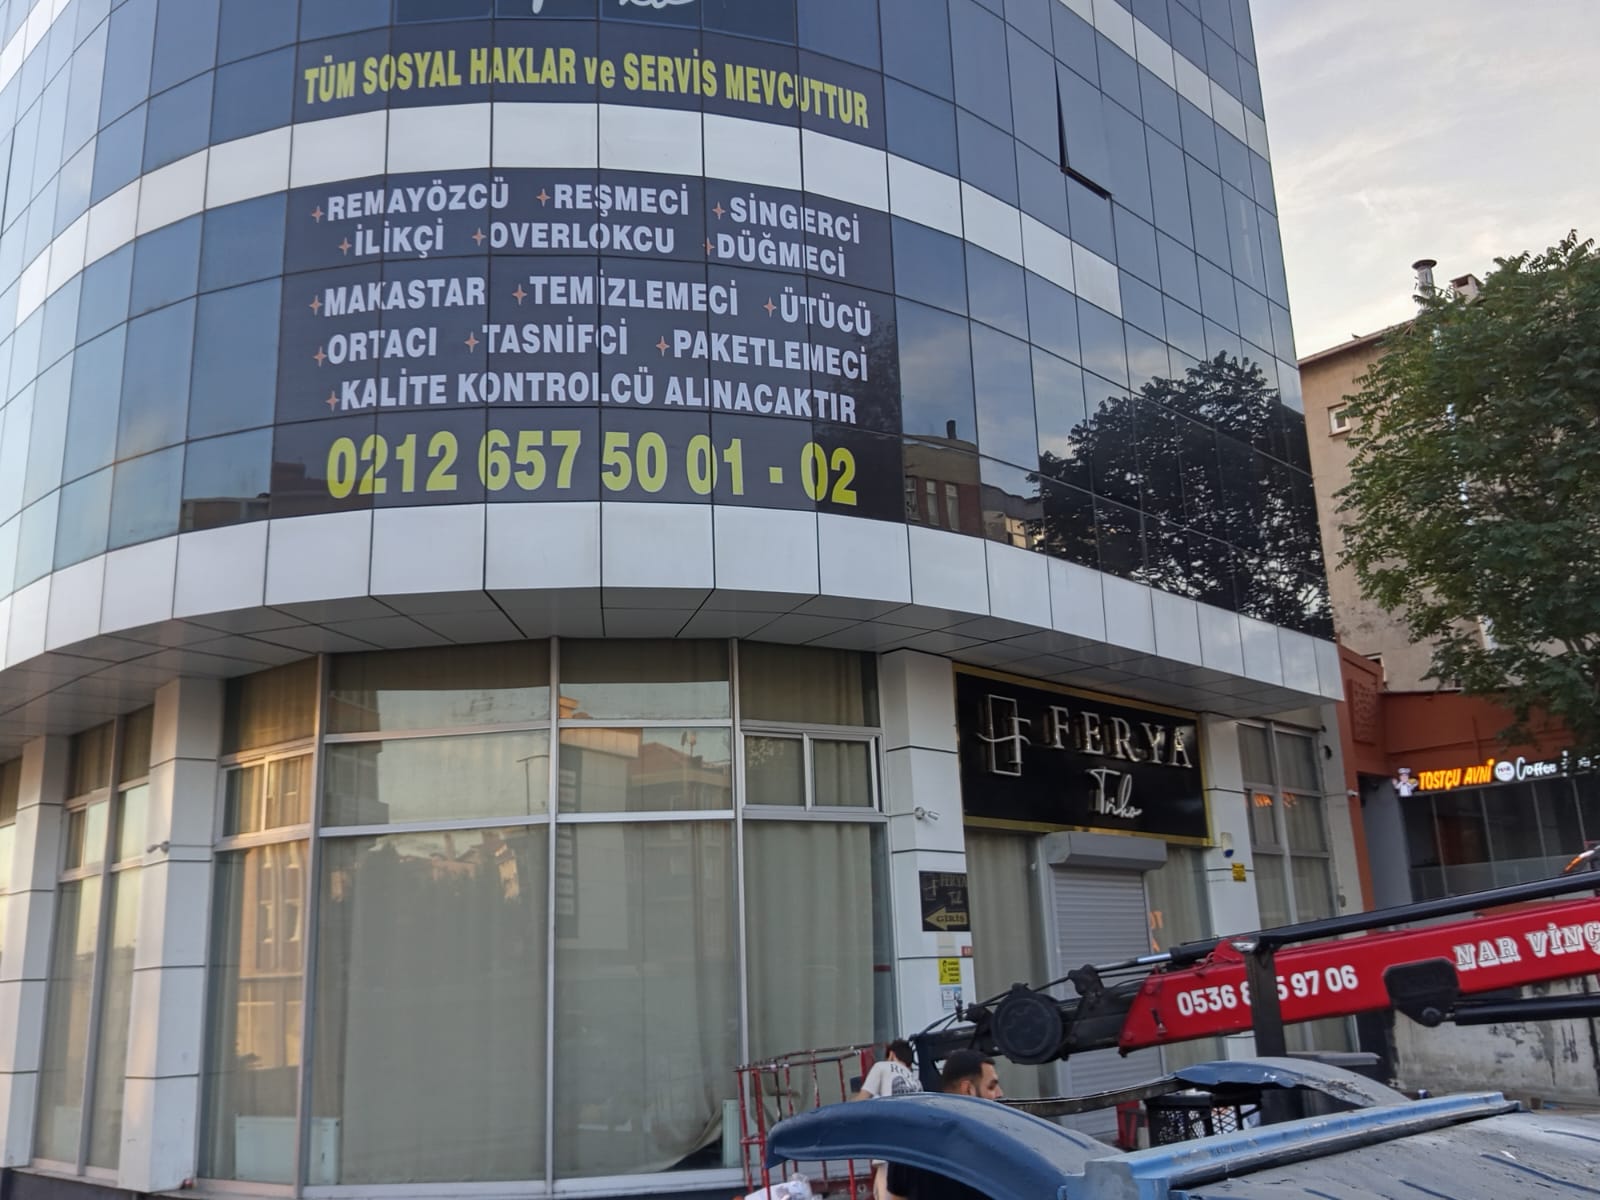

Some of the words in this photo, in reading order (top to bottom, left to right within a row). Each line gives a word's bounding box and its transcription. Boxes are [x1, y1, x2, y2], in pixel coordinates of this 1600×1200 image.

[305, 55, 354, 104] TÜM
[363, 49, 461, 92] SOSYAL
[470, 47, 576, 85] HAKLAR
[584, 58, 615, 88] ve
[623, 48, 717, 97] SERVİS
[725, 63, 868, 129] MEVCUTTUR
[327, 176, 509, 221] REMAYÖZCÜ
[554, 183, 689, 218] REŞMECİ
[730, 192, 860, 243] SİNGERCİ
[354, 219, 444, 258] İLİKÇİ
[489, 221, 674, 253] OVERLOKCU
[716, 227, 845, 277] DÜĞMECİ
[324, 276, 485, 317] MAKASTAR
[529, 271, 738, 316] TEMİZLEMECİ
[779, 287, 871, 336] ÜTÜCÜ
[328, 327, 437, 364] ORTACI
[482, 318, 628, 354] TASNİFCİ
[674, 329, 868, 381] PAKETLEMECİ
[341, 368, 447, 410] KALİTE
[458, 366, 654, 404] KONTROLCÜ
[664, 381, 857, 424] ALINACAKTIR
[328, 432, 458, 499] 0212
[478, 429, 581, 491] 657
[602, 433, 668, 494] 50
[686, 435, 744, 494] 01
[801, 441, 857, 506] 02
[1050, 705, 1192, 768] FERYA
[1418, 768, 1461, 790] TOSTÇU
[1464, 759, 1495, 784] AVNİ
[1516, 756, 1557, 781] Coffee
[1452, 936, 1522, 972] NAR
[1525, 922, 1600, 958] VİNÇ
[1176, 984, 1238, 1016] 0536
[1240, 975, 1289, 1006] 85
[1290, 970, 1319, 997] 97
[1325, 965, 1359, 992] 06
